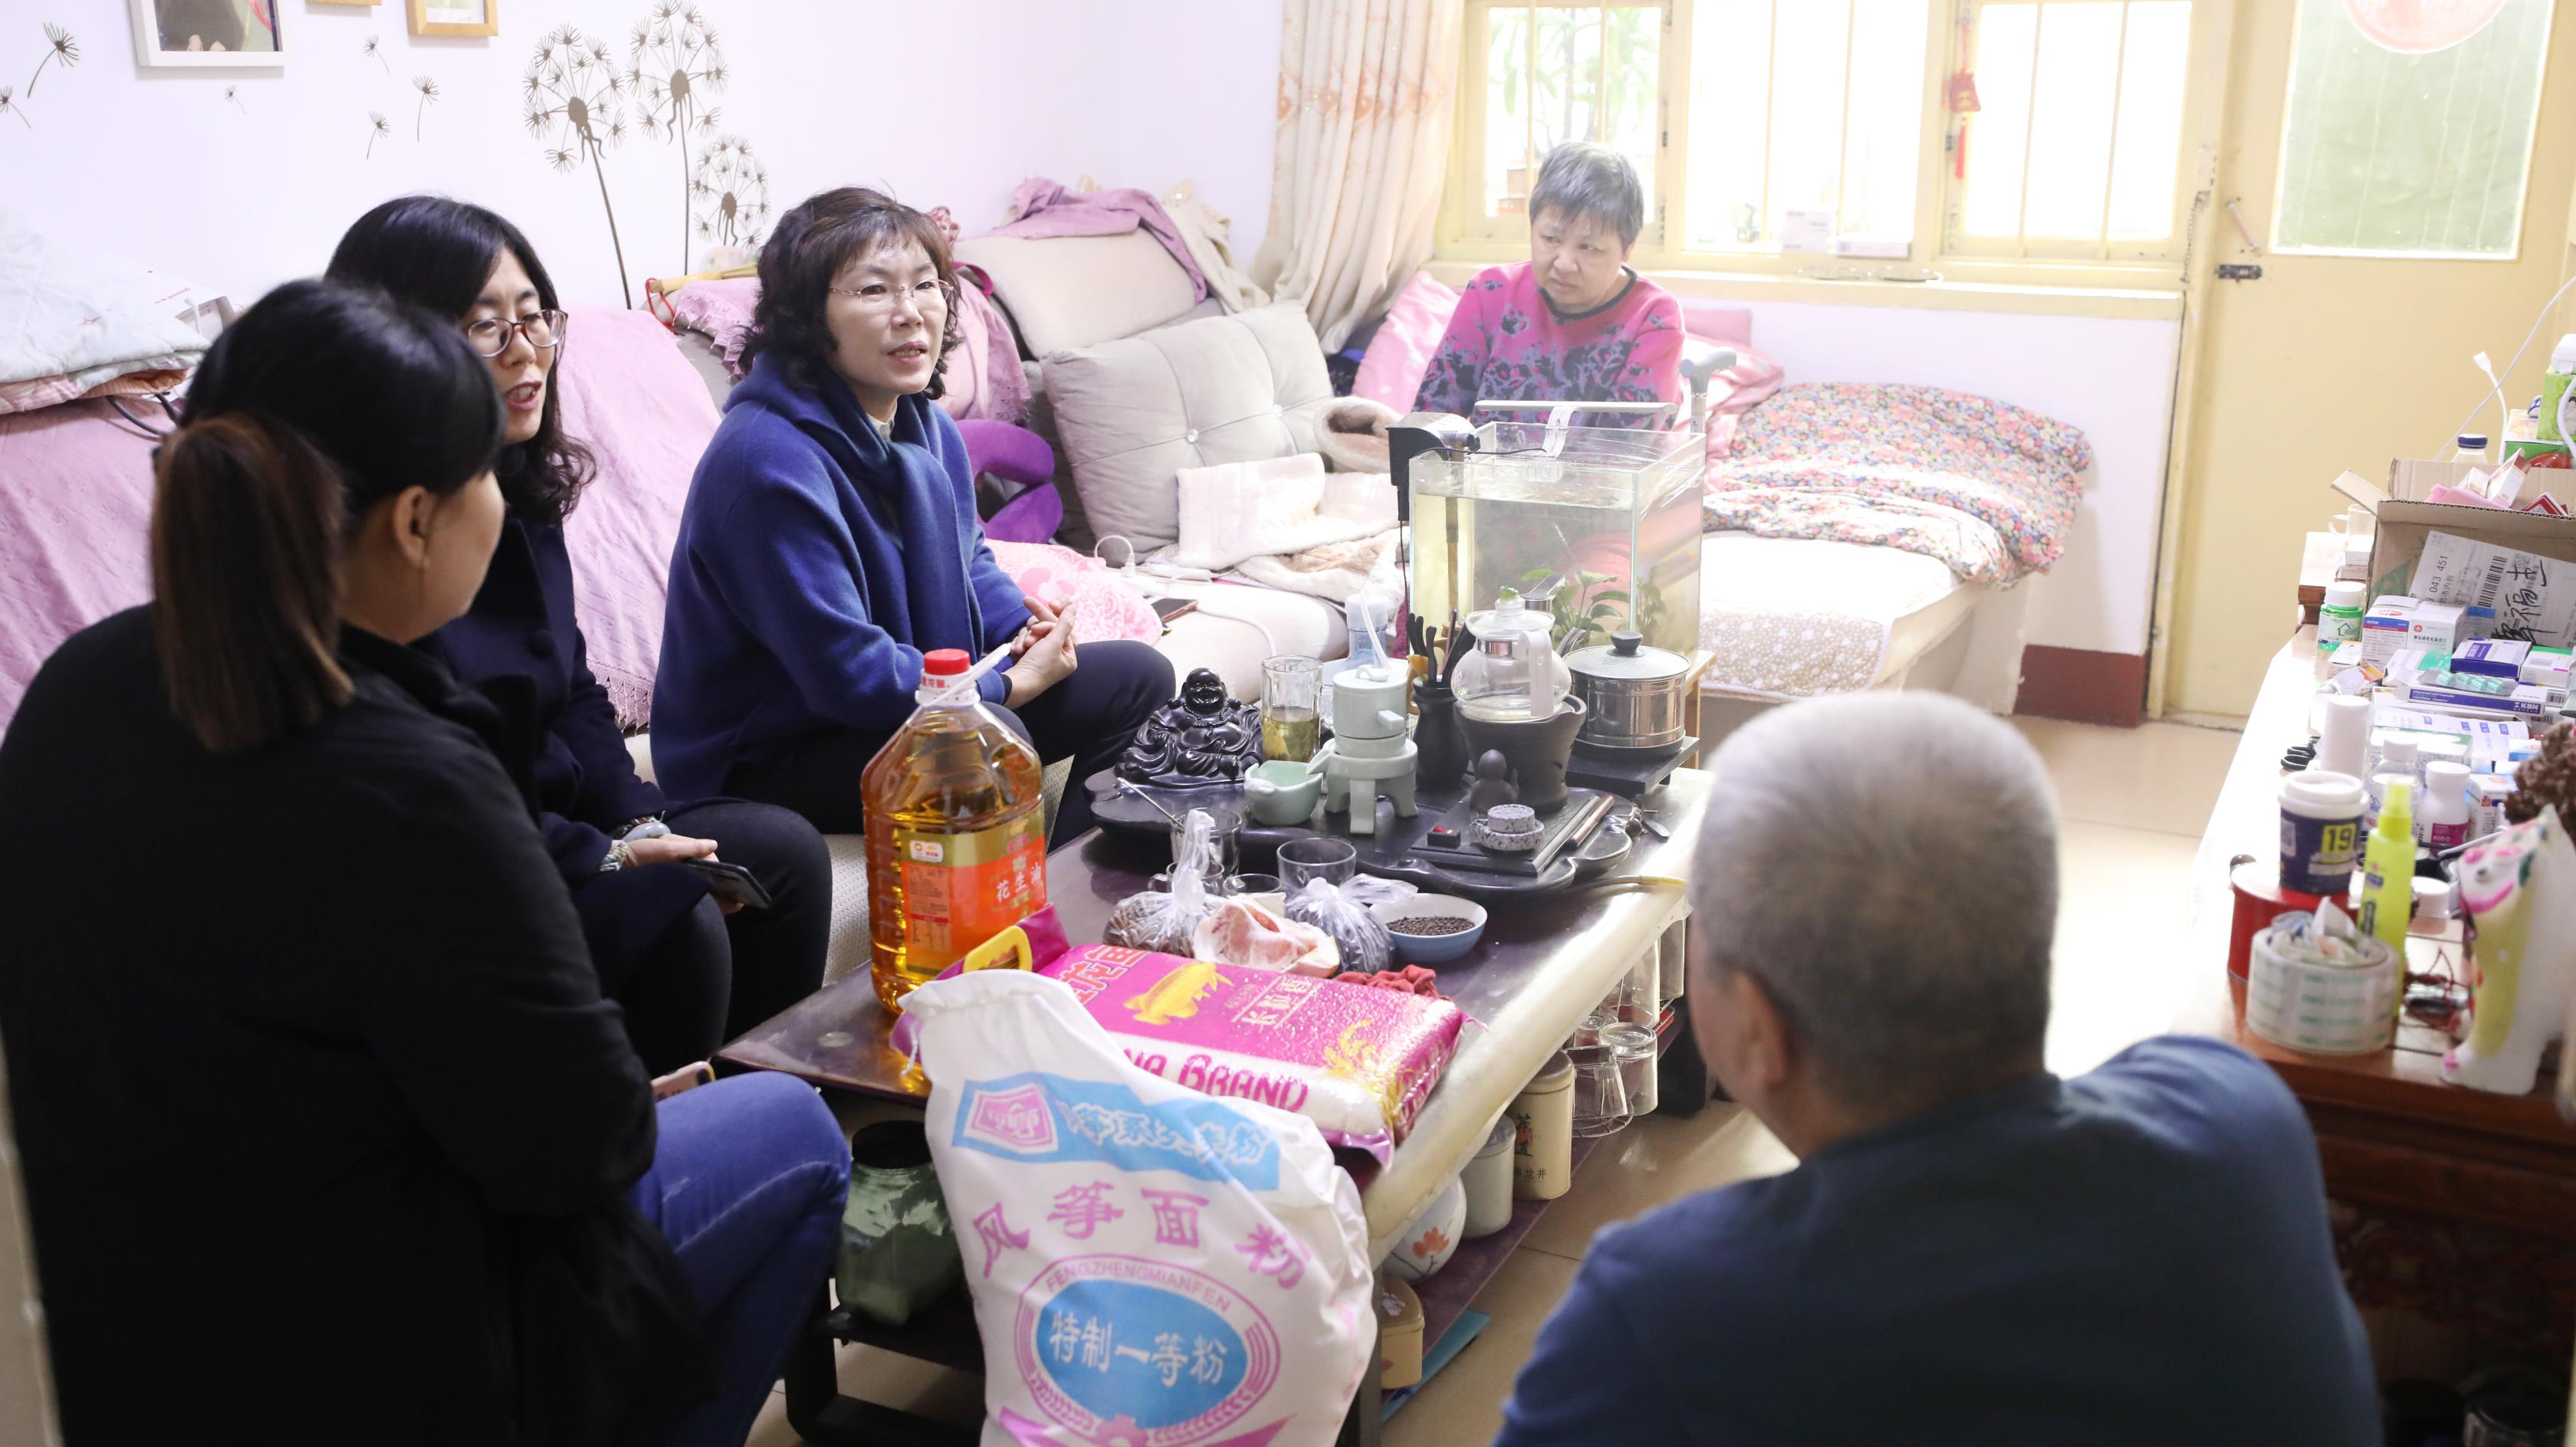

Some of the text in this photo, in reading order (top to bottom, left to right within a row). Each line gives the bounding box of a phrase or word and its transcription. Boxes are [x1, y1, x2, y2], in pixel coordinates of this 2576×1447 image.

[2430, 576, 2443, 593] 043
[2436, 554, 2450, 573] 451
[2520, 701, 2539, 711] KBN
[2327, 827, 2353, 851] 19
[995, 861, 1043, 903] 花生油
[1242, 977, 1313, 1029] 长粒香
[1178, 1054, 1308, 1114] BRAND
[972, 1180, 1312, 1290] 风筝面粉
[1045, 1261, 1231, 1312] FENGZHENGMIANFEN
[1049, 1308, 1227, 1388] 特制一等粉
